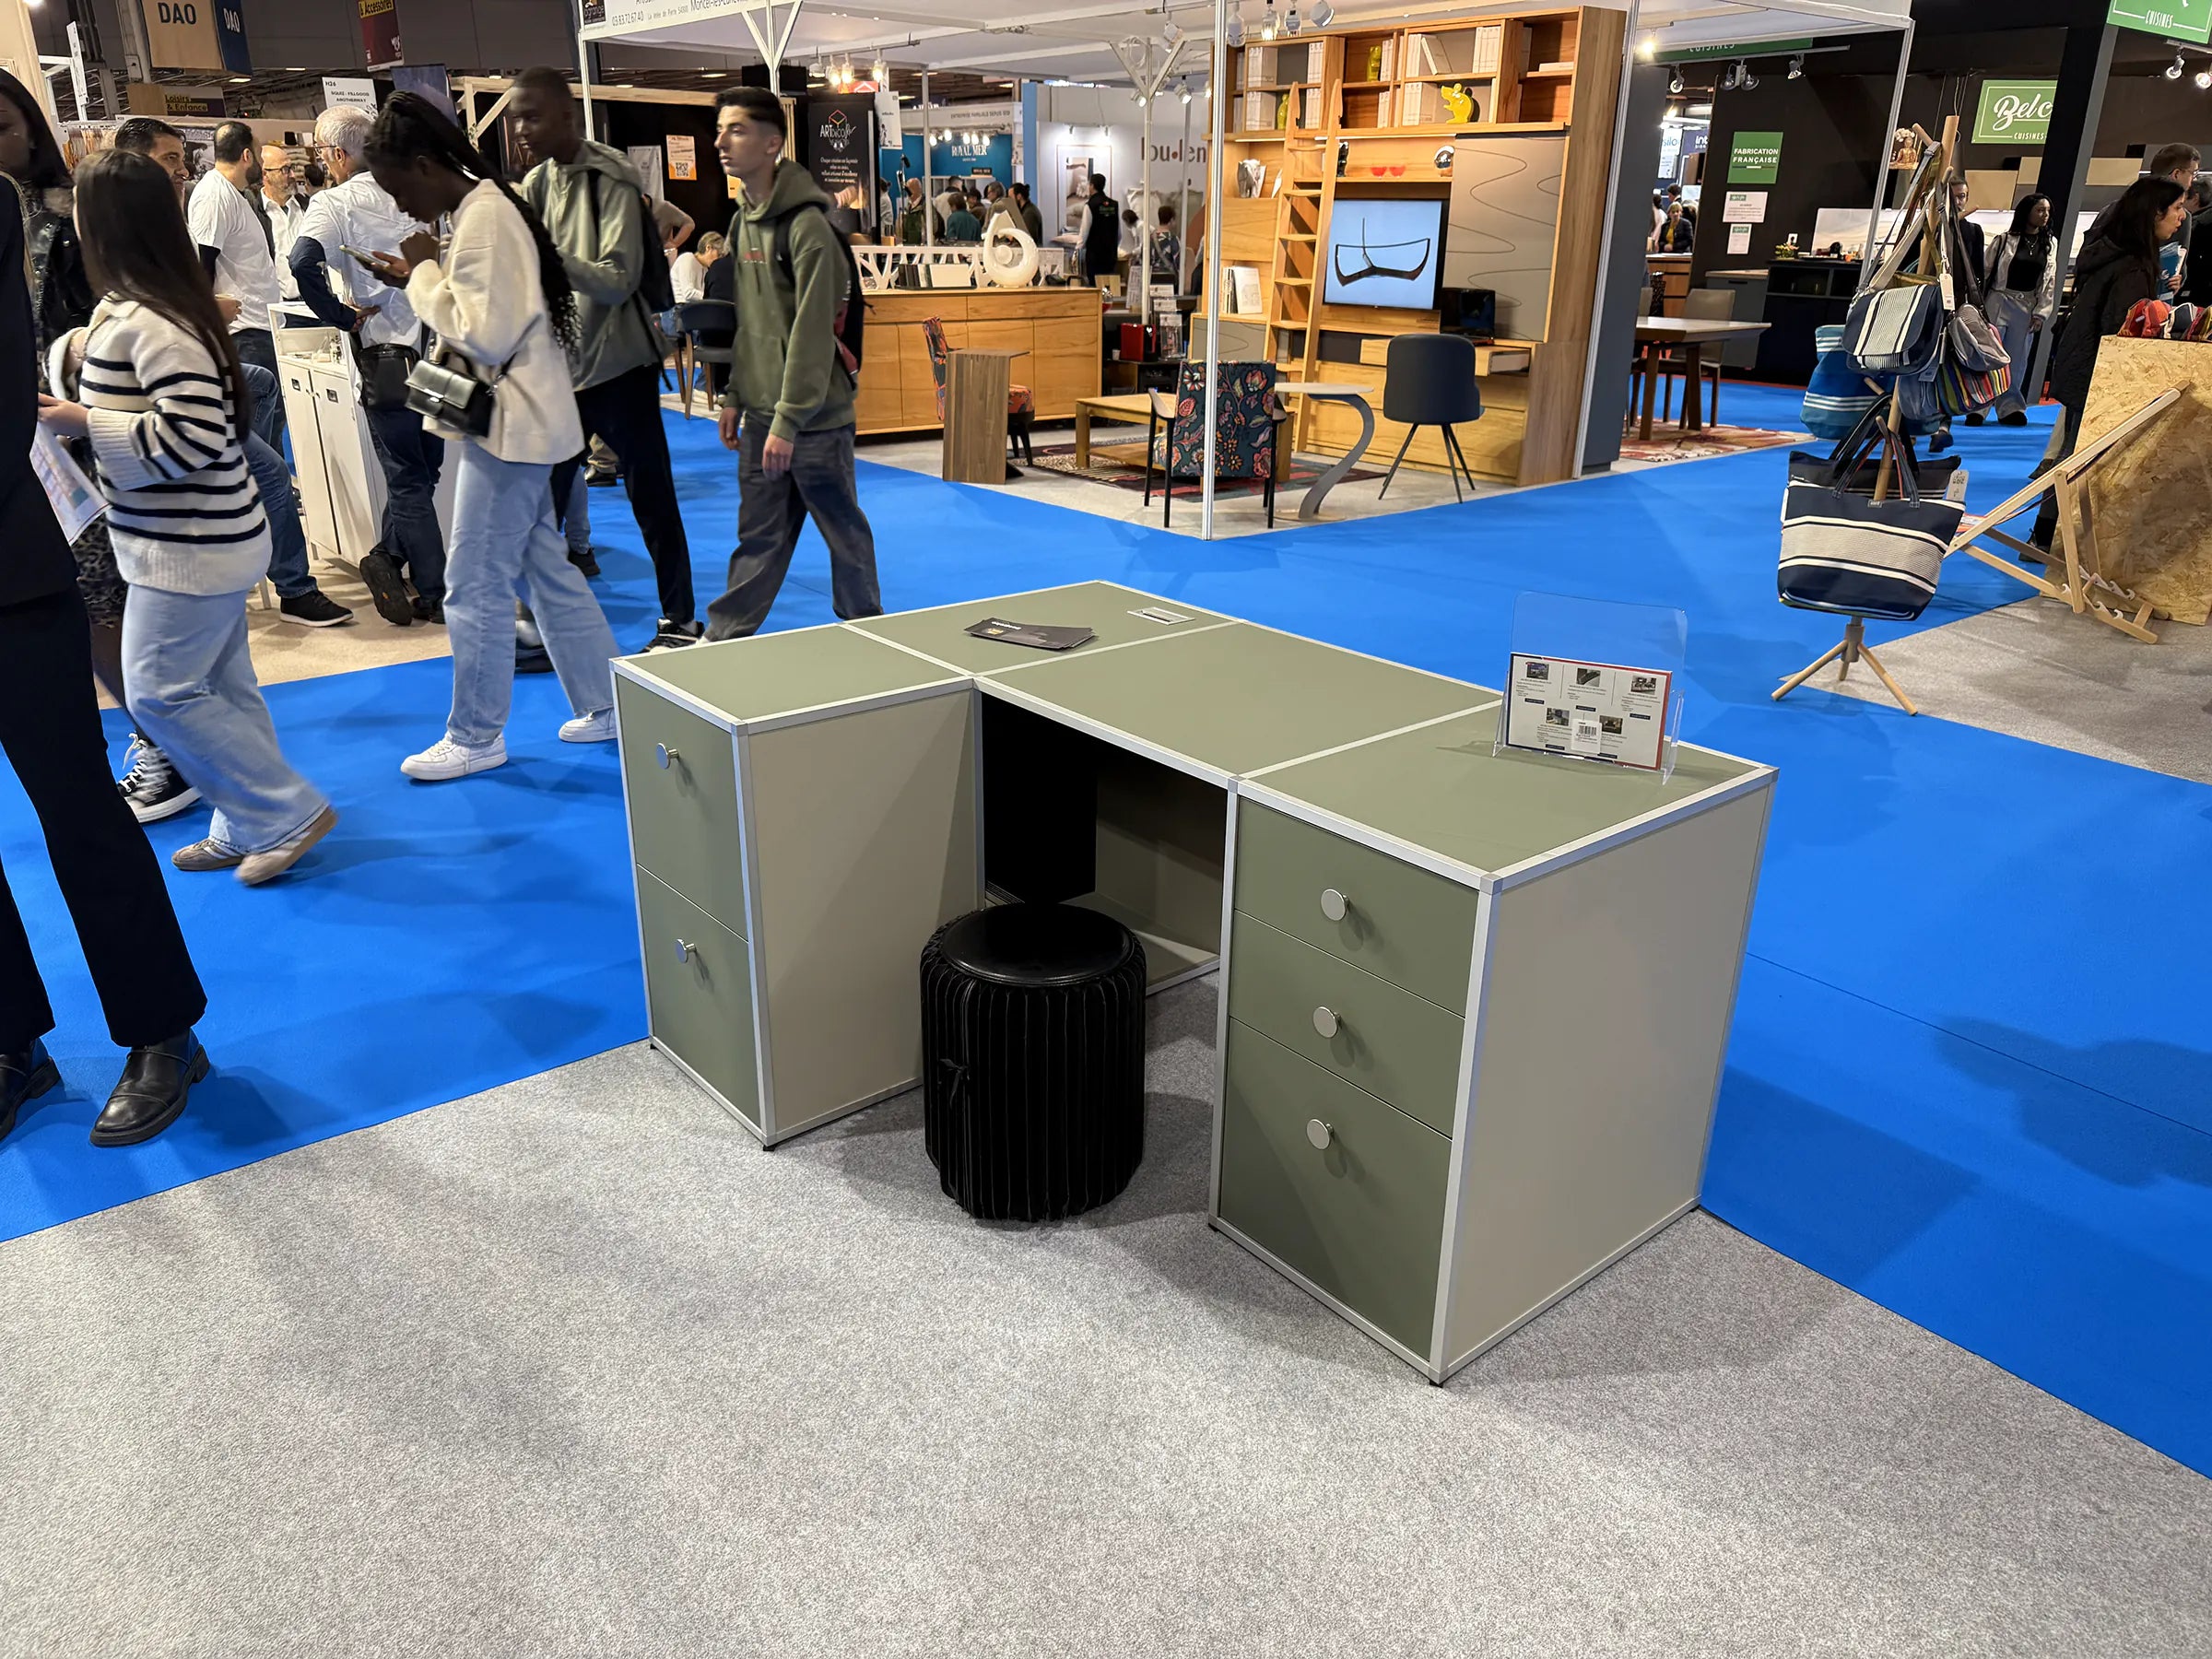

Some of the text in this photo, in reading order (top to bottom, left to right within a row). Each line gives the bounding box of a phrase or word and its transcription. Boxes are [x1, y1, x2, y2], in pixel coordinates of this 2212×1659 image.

[158, 2, 197, 25] DAO
[223, 7, 241, 33] DAO
[2146, 9, 2173, 29] CUISINES
[166, 94, 192, 103] Loisirs
[1733, 156, 1778, 164] FRANÇAISE
